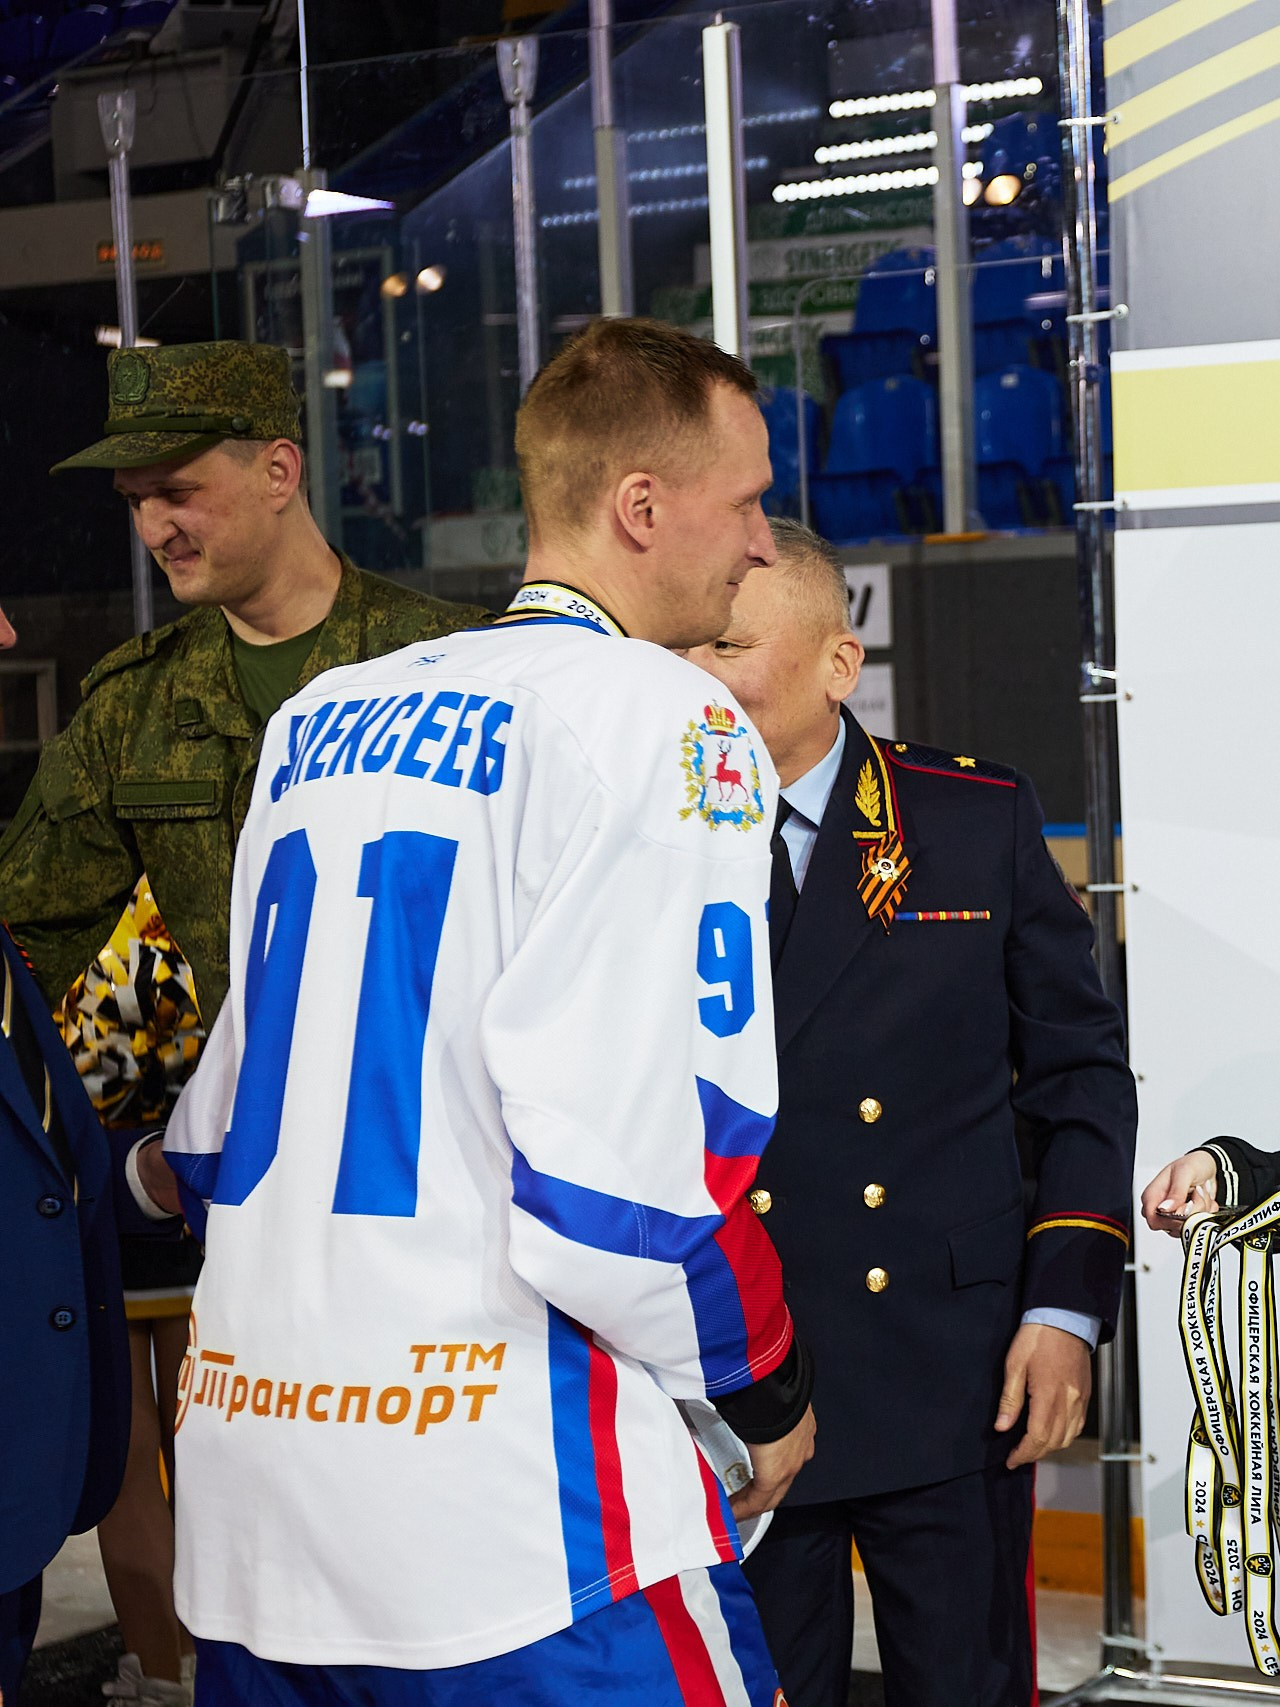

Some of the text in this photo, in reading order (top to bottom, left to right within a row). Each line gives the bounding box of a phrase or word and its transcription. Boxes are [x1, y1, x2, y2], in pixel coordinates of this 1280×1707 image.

[696, 901, 770, 1039] 9
[209, 826, 459, 1218] 91
[1186, 1261, 1204, 1351] ХОККЕЙНАЯ
[409, 1342, 507, 1374] ТТМ
[1195, 1356, 1230, 1456] ОФИЦЕРСКАЯ
[1247, 1280, 1264, 1525] ОФИЦЕРСКАЯ ХОККЕЙНАЯ ЛИГА
[1195, 1480, 1207, 1513] 2024
[1203, 1552, 1220, 1586] 2024
[1226, 1539, 1240, 1571] 2025
[1253, 1610, 1269, 1640] 2024
